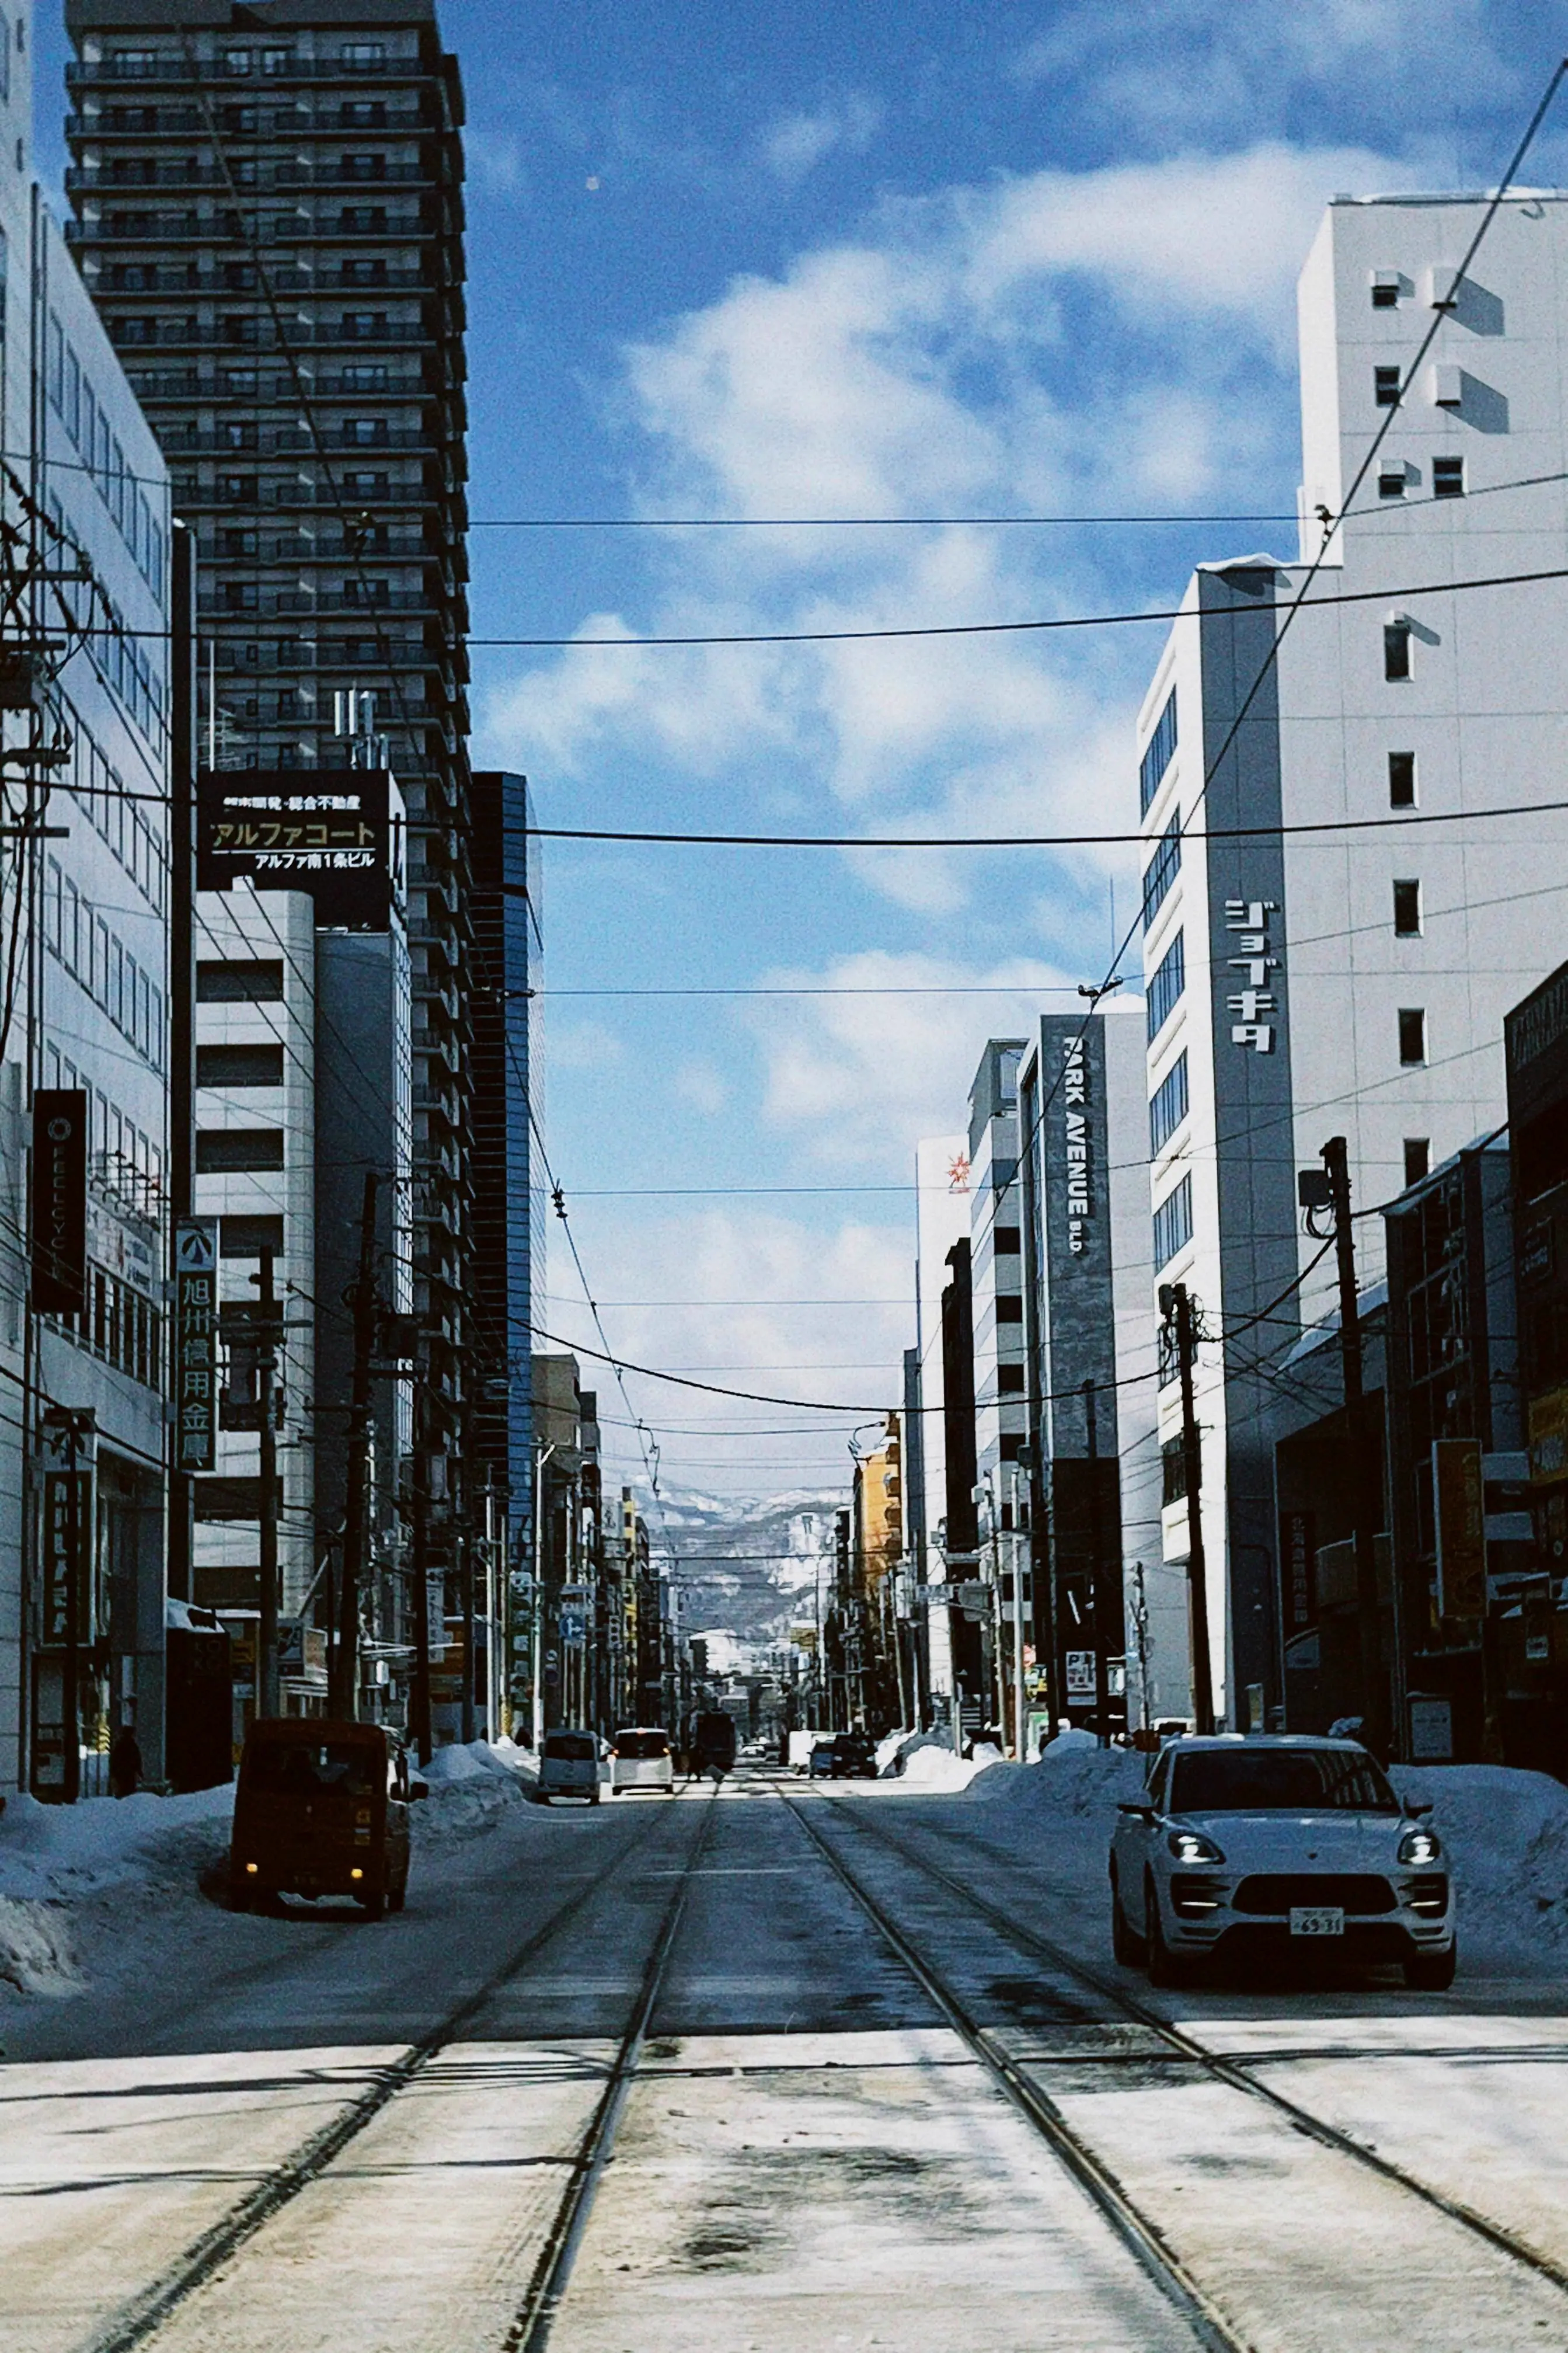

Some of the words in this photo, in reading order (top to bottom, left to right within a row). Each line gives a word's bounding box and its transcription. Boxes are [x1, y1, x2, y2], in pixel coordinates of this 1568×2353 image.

[213, 822, 375, 847] アルファコート
[255, 853, 375, 870] アルファ南1条ビル
[1225, 900, 1278, 1053] ジョブキタ
[1064, 1035, 1086, 1105] PARK
[1065, 1111, 1088, 1215] AVENUE
[182, 1278, 211, 1467] 旭川信用金庫
